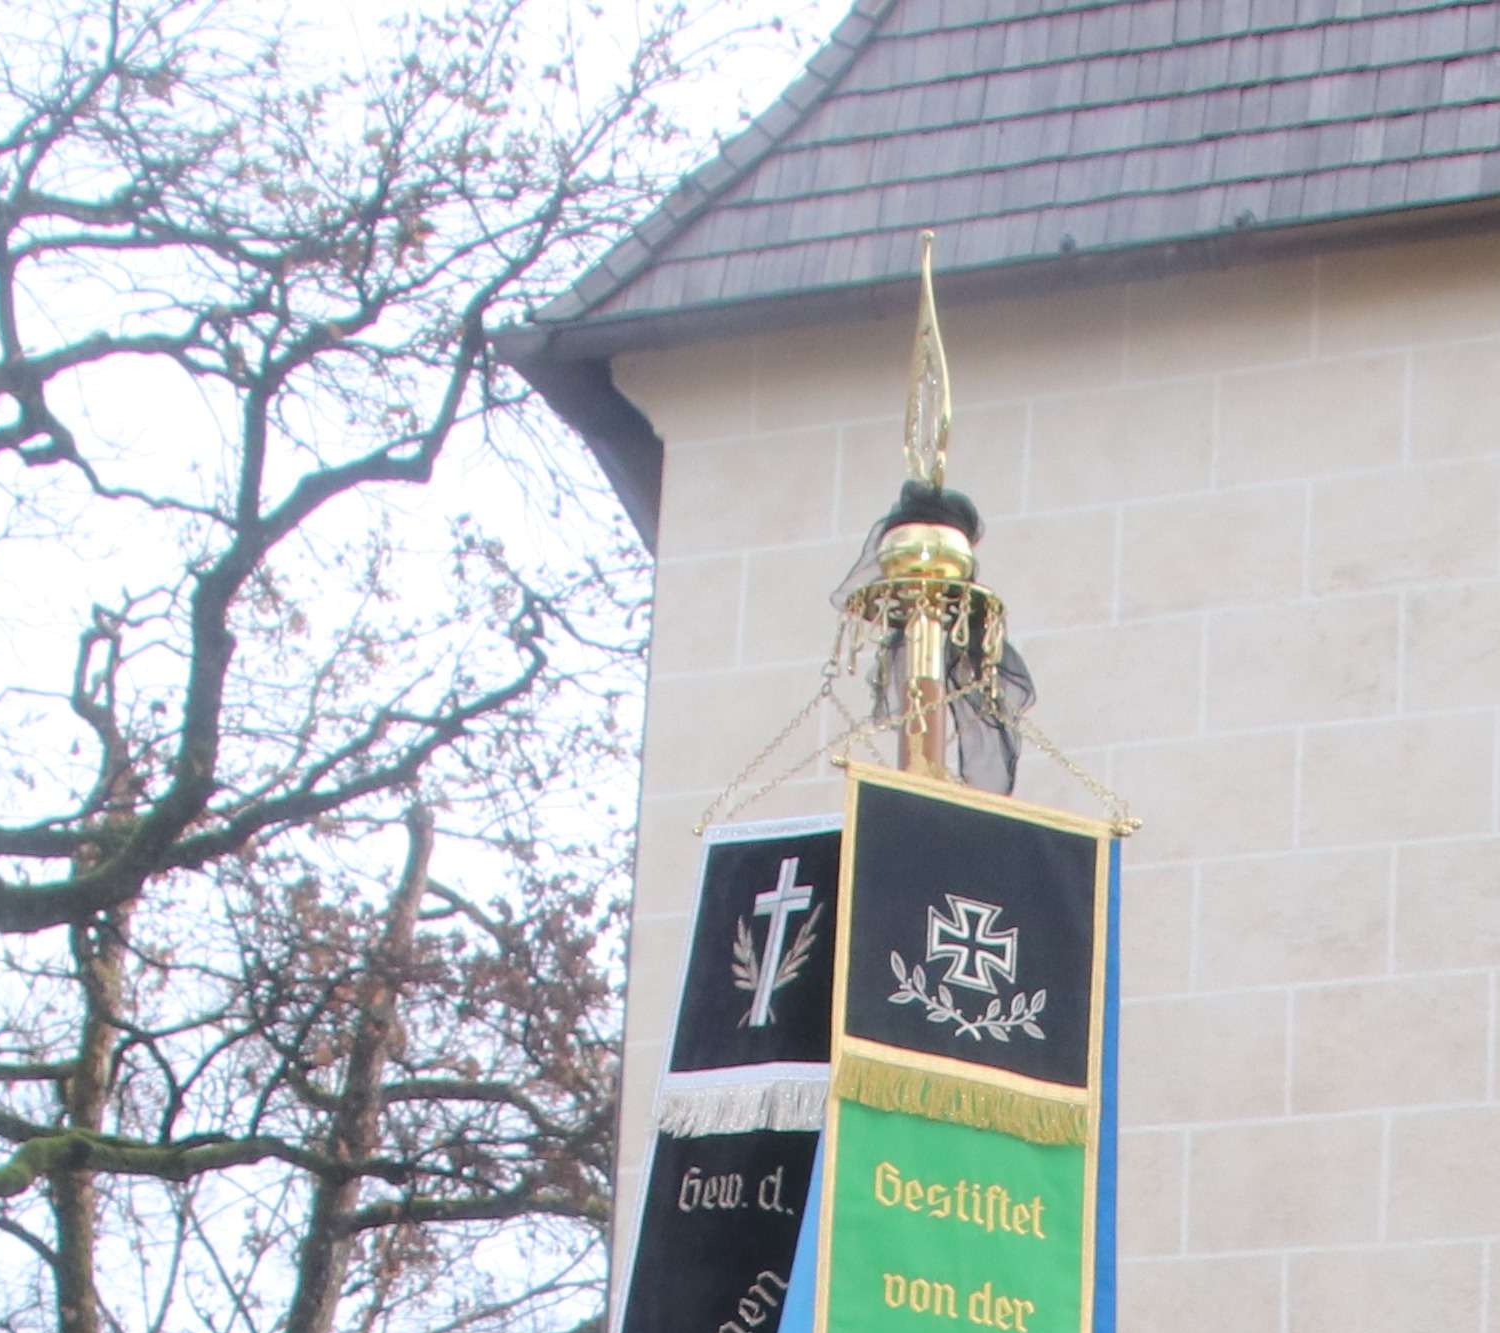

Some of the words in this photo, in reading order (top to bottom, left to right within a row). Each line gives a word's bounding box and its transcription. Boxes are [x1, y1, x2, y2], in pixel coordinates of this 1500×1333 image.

[757, 1164, 795, 1216] d.
[873, 1160, 1047, 1241] Gestiftet
[881, 1271, 959, 1321] von
